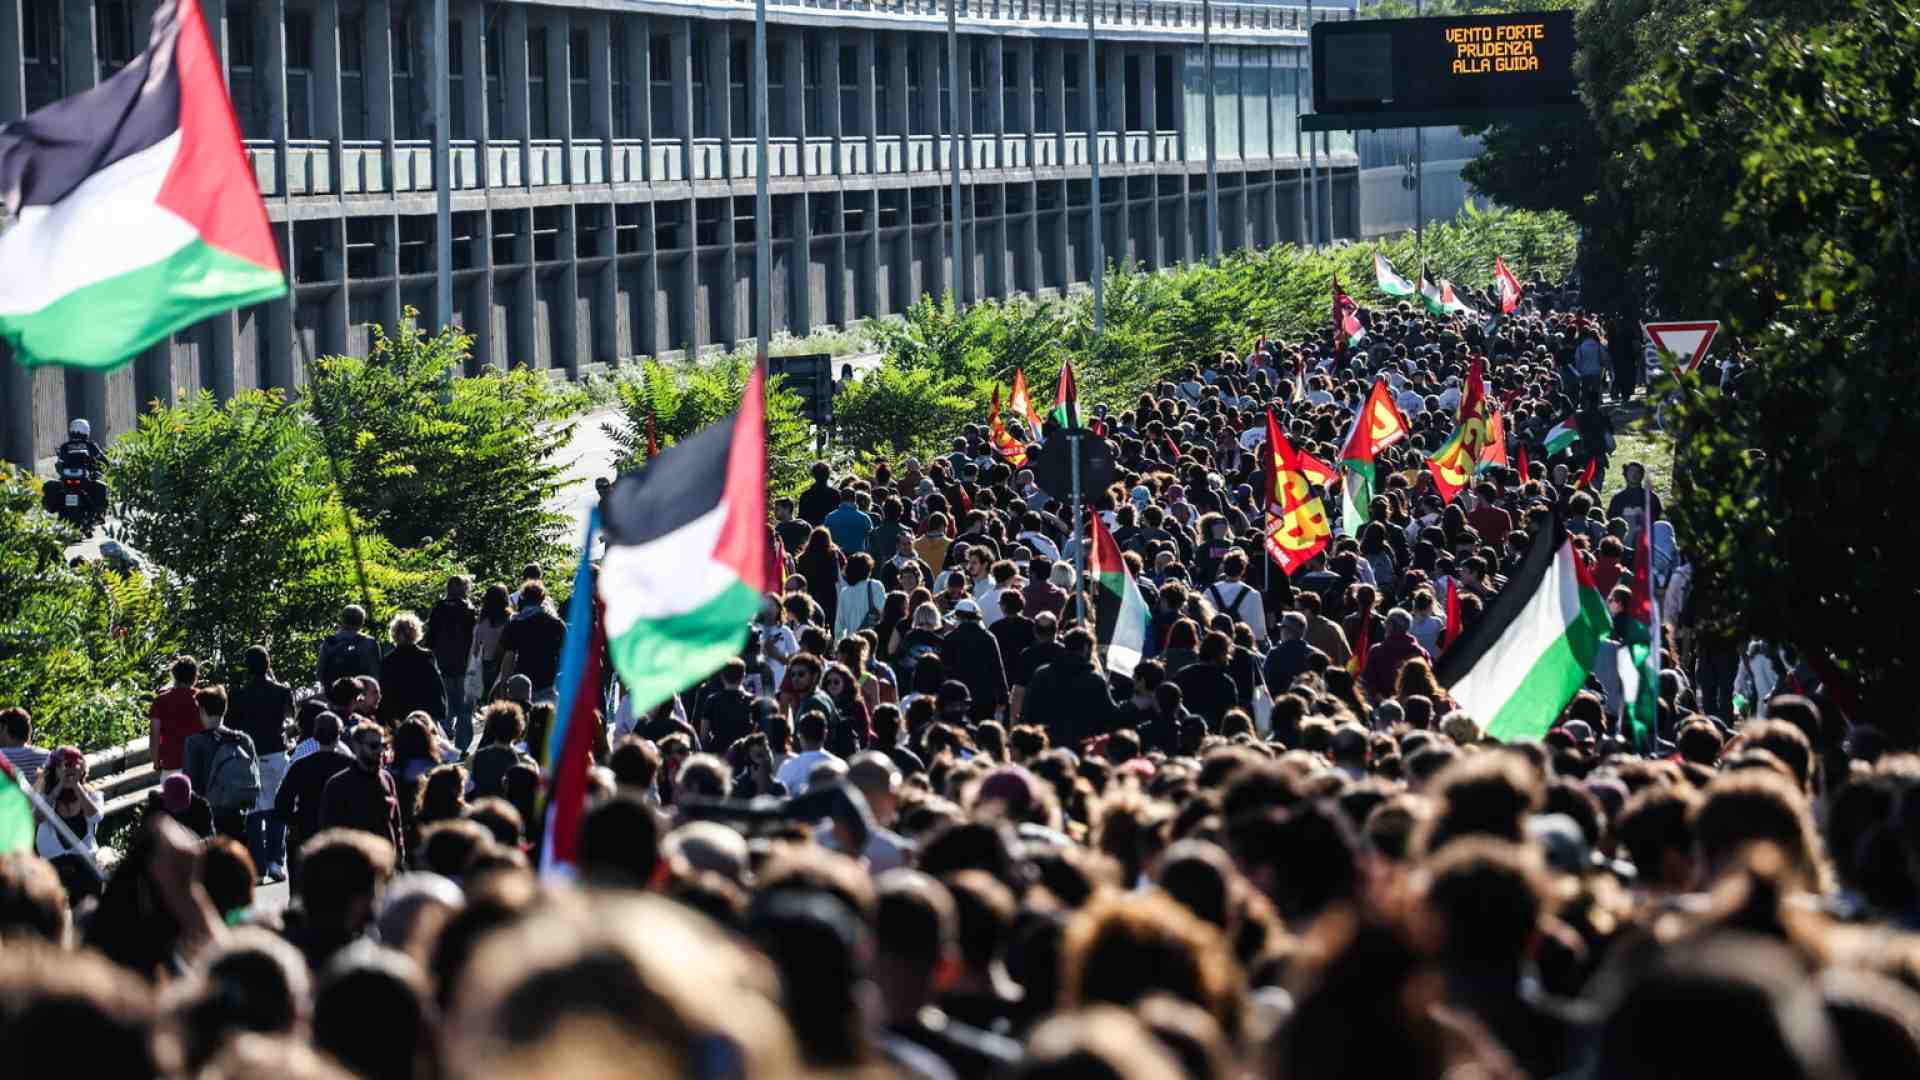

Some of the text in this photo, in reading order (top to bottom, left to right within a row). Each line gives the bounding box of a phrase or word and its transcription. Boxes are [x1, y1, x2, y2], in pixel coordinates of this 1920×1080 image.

[1446, 25, 1544, 42] VENTO FORTE
[1458, 41, 1532, 57] PRUDENZA
[1453, 56, 1538, 73] ALLA GUIDA
